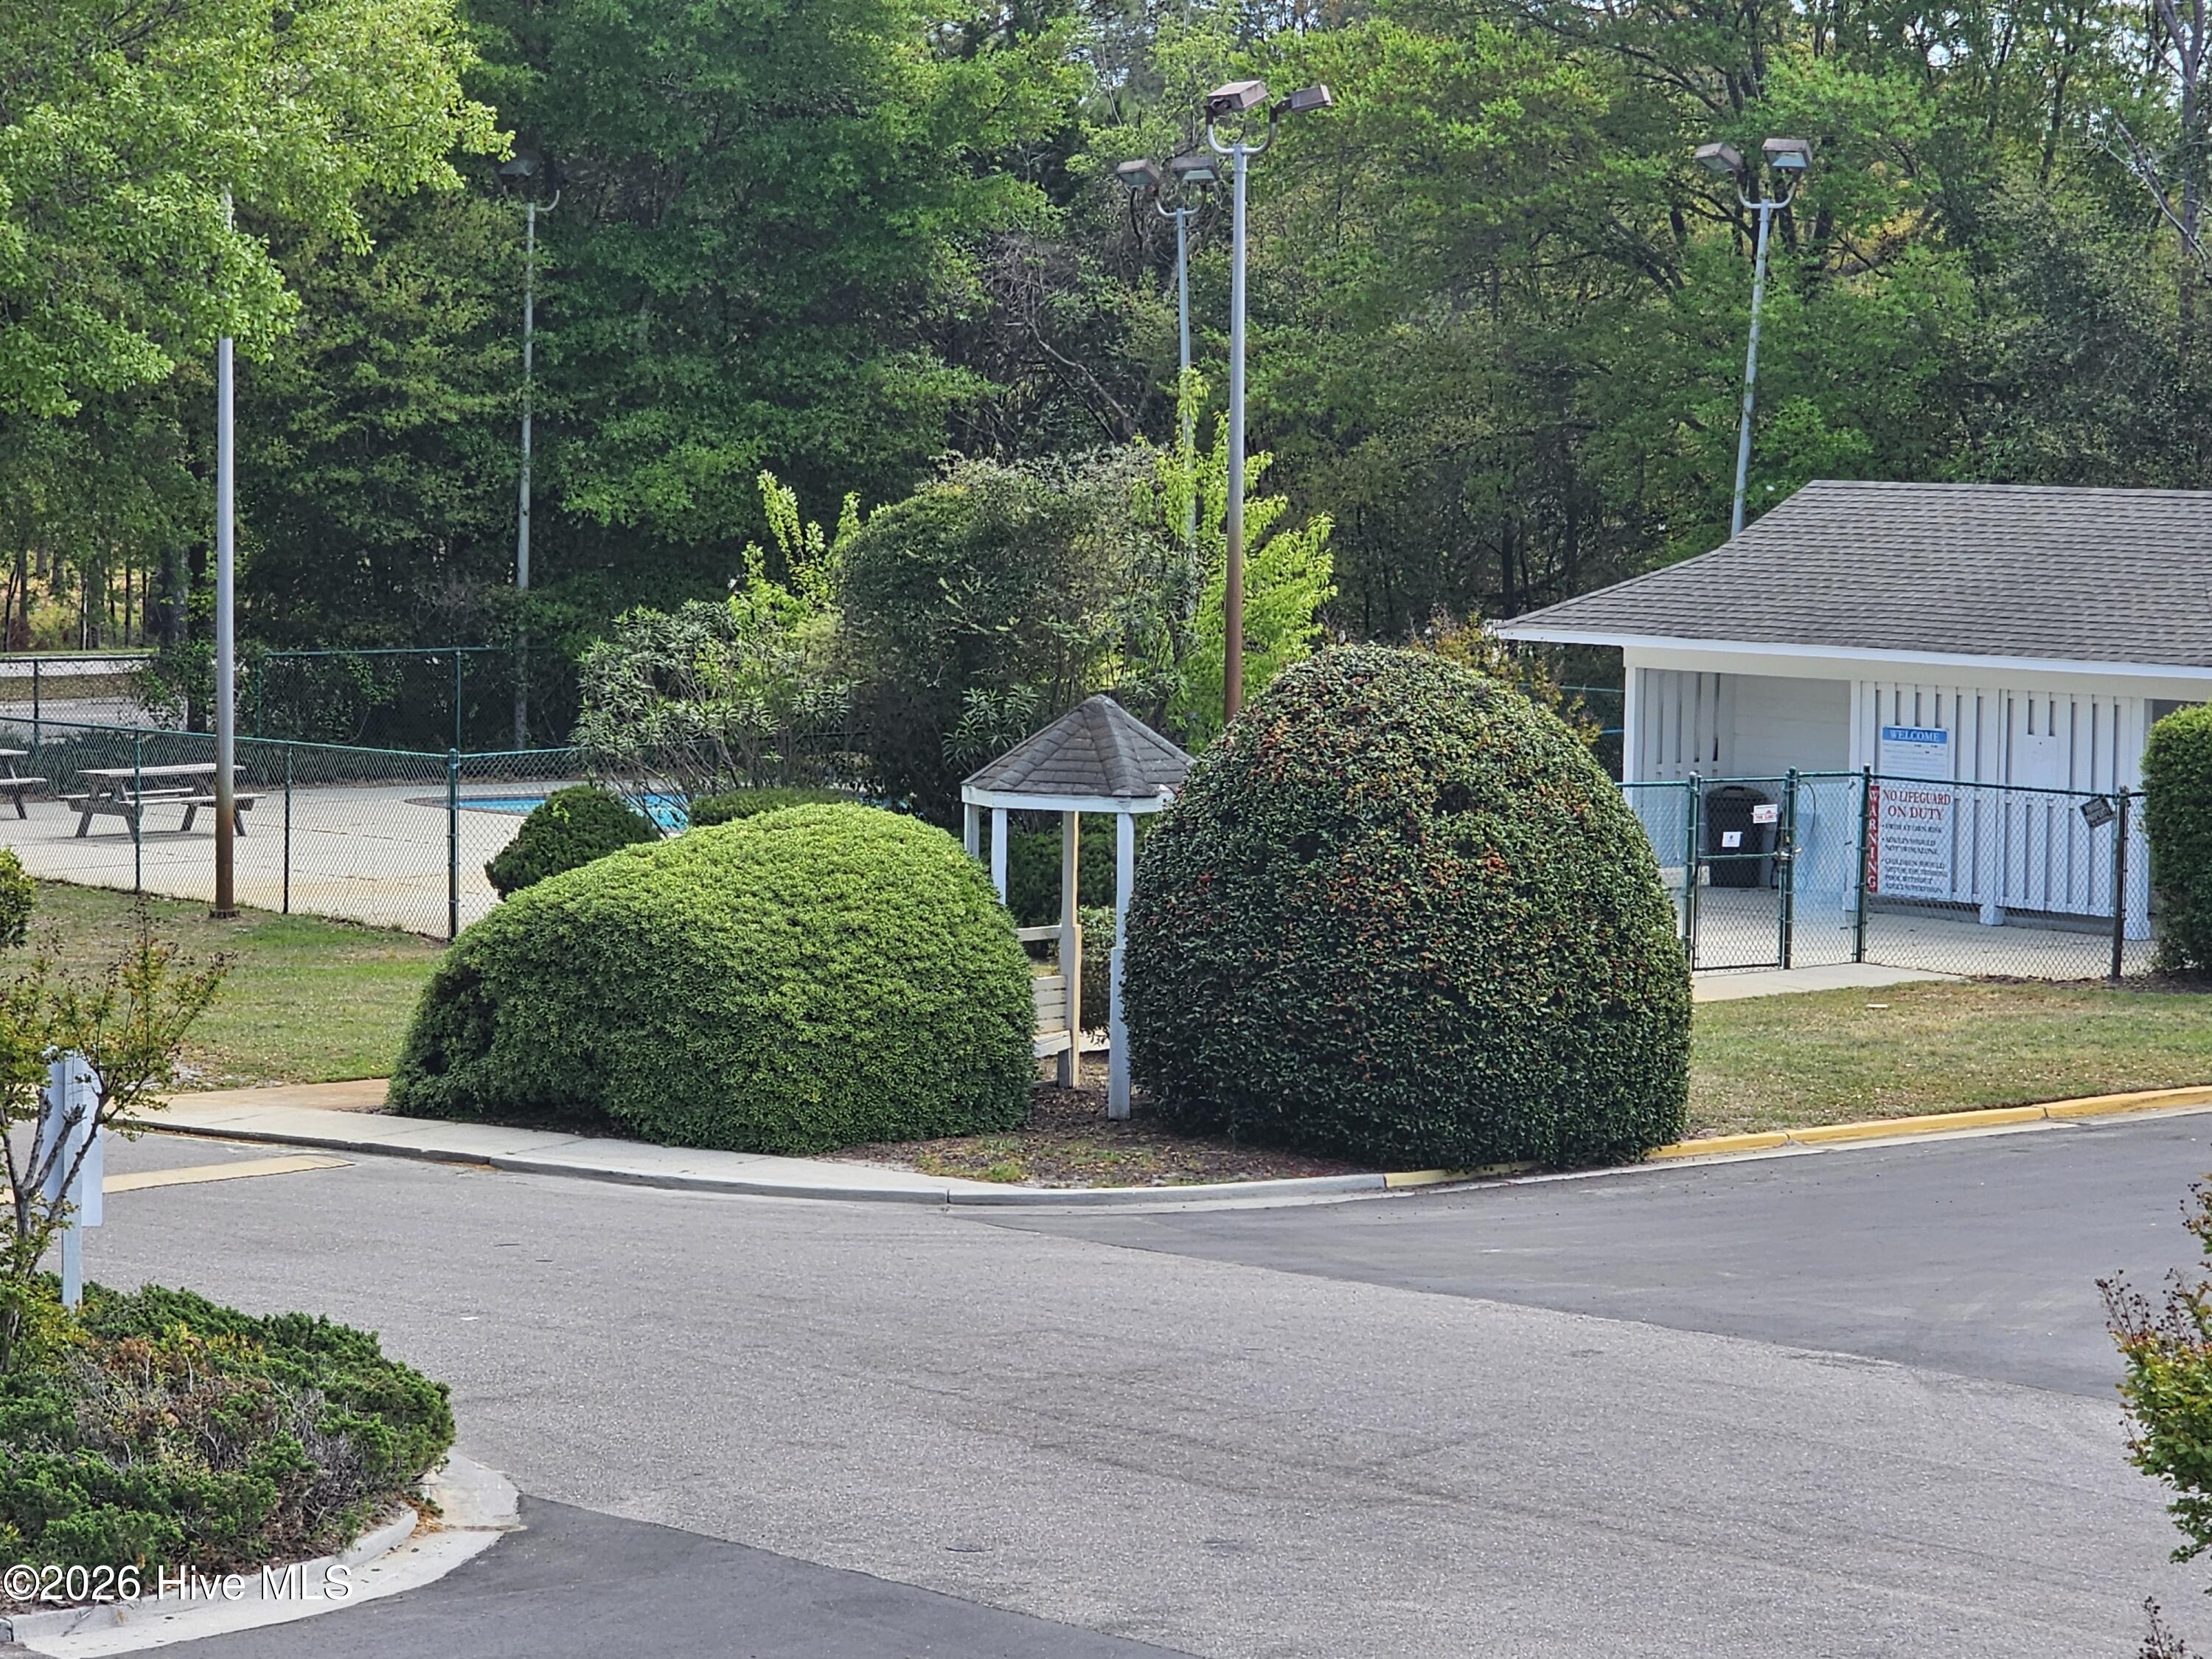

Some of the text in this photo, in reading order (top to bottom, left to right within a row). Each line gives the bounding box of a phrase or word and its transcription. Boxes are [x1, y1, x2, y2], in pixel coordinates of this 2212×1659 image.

[1889, 729, 1940, 742] WELCOME
[1882, 790, 1951, 806] NO LIFEGUARD
[1888, 805, 1944, 821] ON DUTY
[1868, 790, 1879, 888] WARNING
